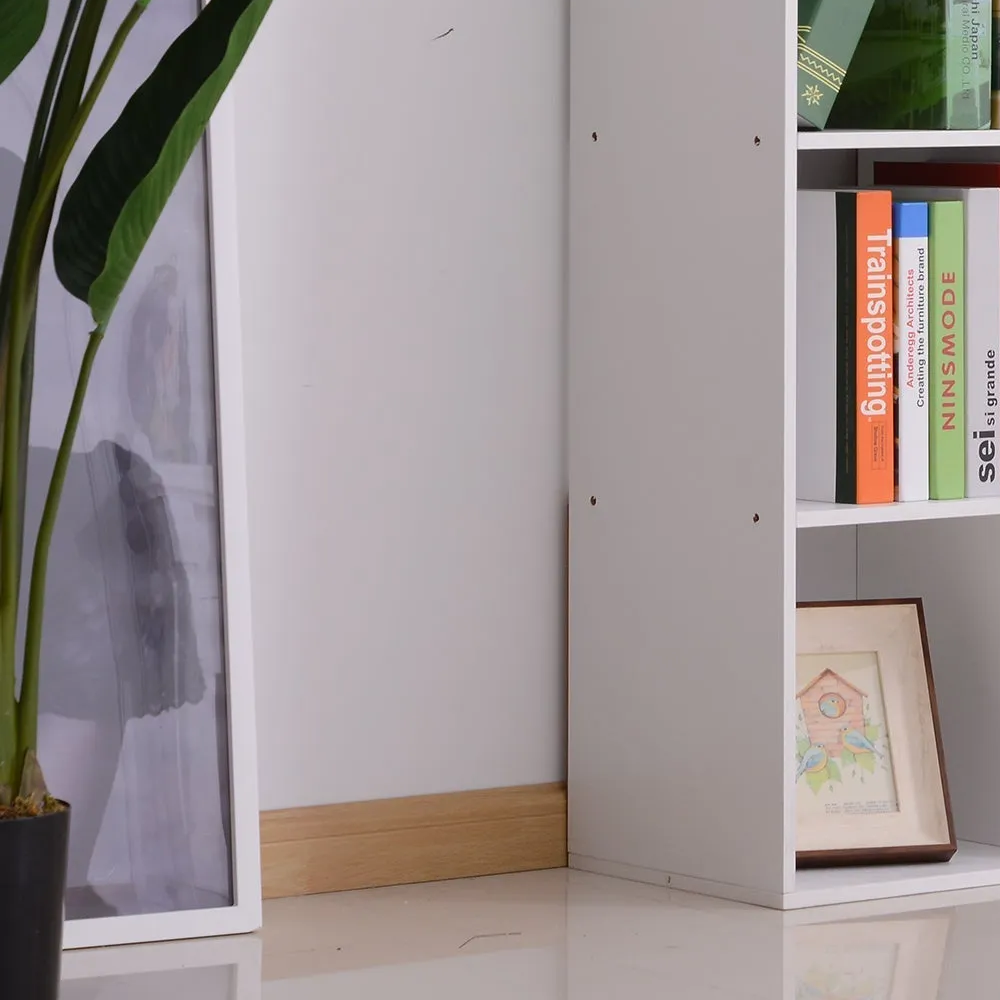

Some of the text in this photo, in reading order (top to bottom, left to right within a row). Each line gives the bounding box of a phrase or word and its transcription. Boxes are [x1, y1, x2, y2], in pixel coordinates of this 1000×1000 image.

[969, 18, 980, 60] Japan
[860, 228, 892, 416] Trainspotting
[906, 268, 915, 388] Anderegg Architects
[917, 248, 926, 407] Creating the furniture brand
[942, 271, 956, 431] NINSMODE
[973, 349, 998, 483] sei si grande
